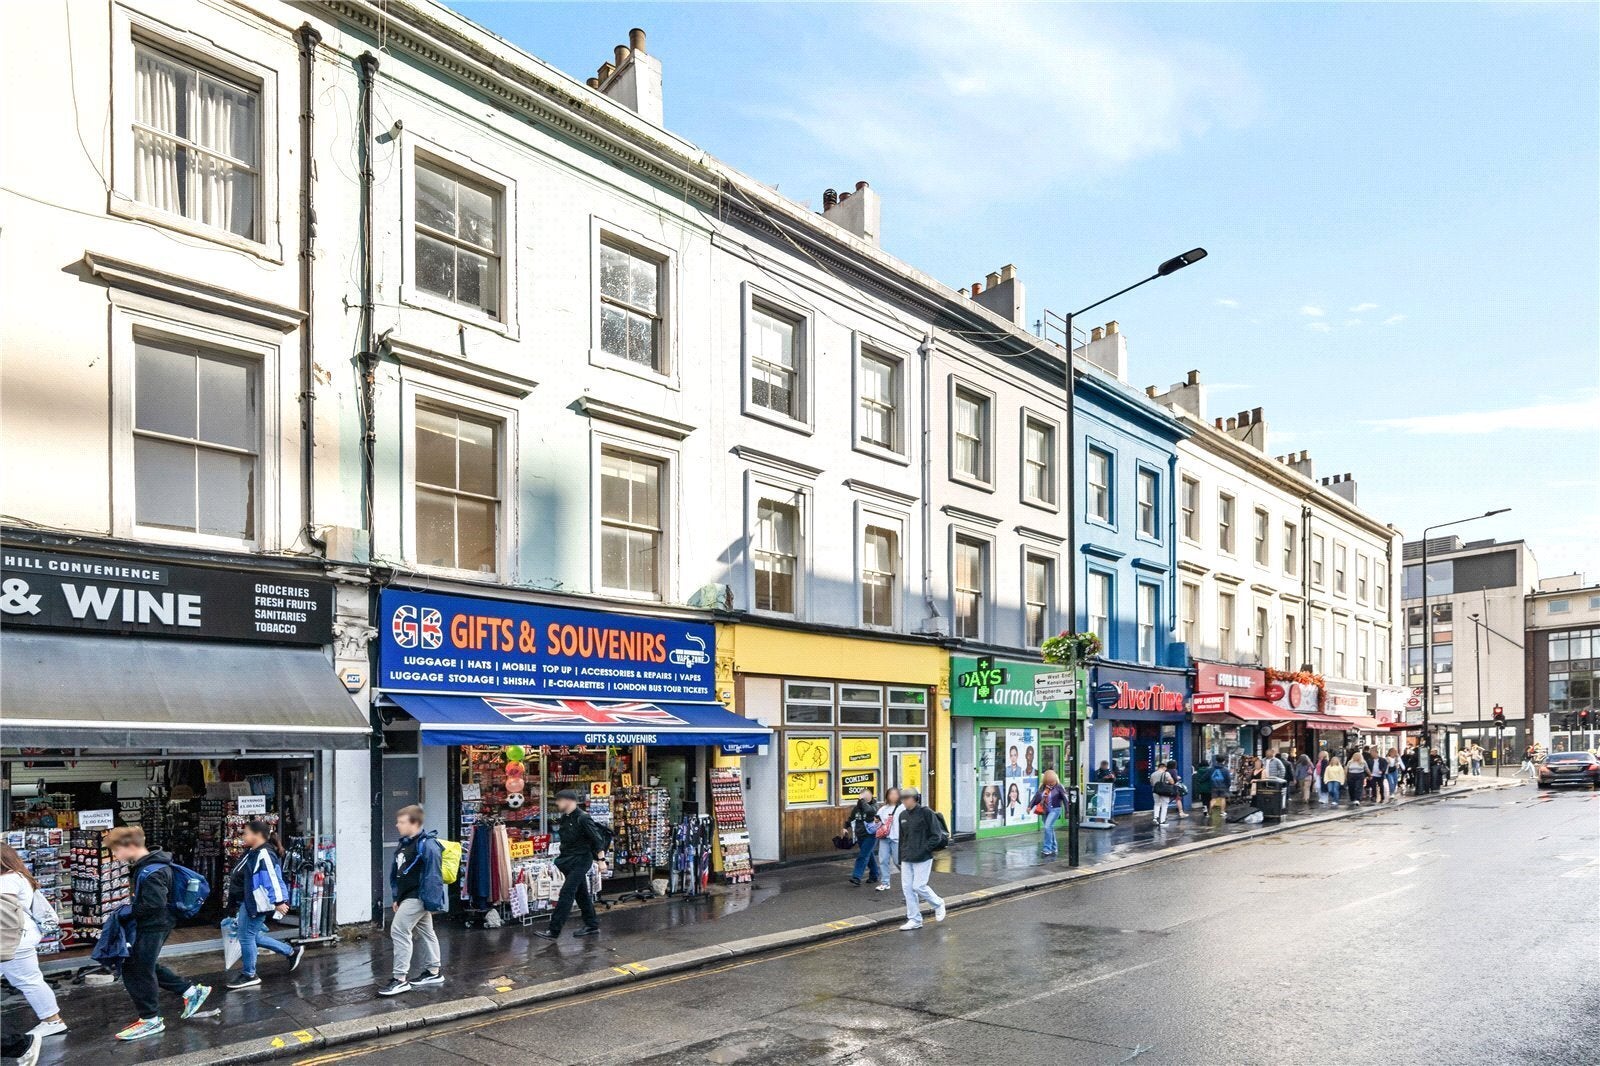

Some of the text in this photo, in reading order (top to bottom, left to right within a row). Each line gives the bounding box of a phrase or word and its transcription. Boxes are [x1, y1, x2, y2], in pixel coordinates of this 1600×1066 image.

[4, 555, 160, 581] HILL CONVENIENCE
[254, 583, 310, 598] GROCERIES
[0, 577, 202, 627] & WINE
[255, 596, 317, 611] FRESH FRUITS
[254, 609, 307, 622] SANITARIES
[254, 622, 297, 634] TOBACCO
[392, 604, 667, 664] GB GIFTS & SOUVENIRS
[404, 656, 457, 667] LUGGAGE
[467, 660, 492, 669] HATS
[502, 662, 537, 672] MOBILE
[542, 664, 559, 673] TOP
[561, 665, 572, 674] UP
[580, 667, 635, 678] ACCESSORIES
[643, 671, 672, 680] REPAIRS
[679, 673, 701, 682] VAPES
[390, 671, 708, 694] LUGGAGE STORAGE SHISHA E-CIGARETTES LONDON BUS TOUR TICKETS
[584, 734, 657, 744] GIFTS & SOUVENIRS
[844, 774, 869, 784] COMING
[593, 784, 607, 795] £1
